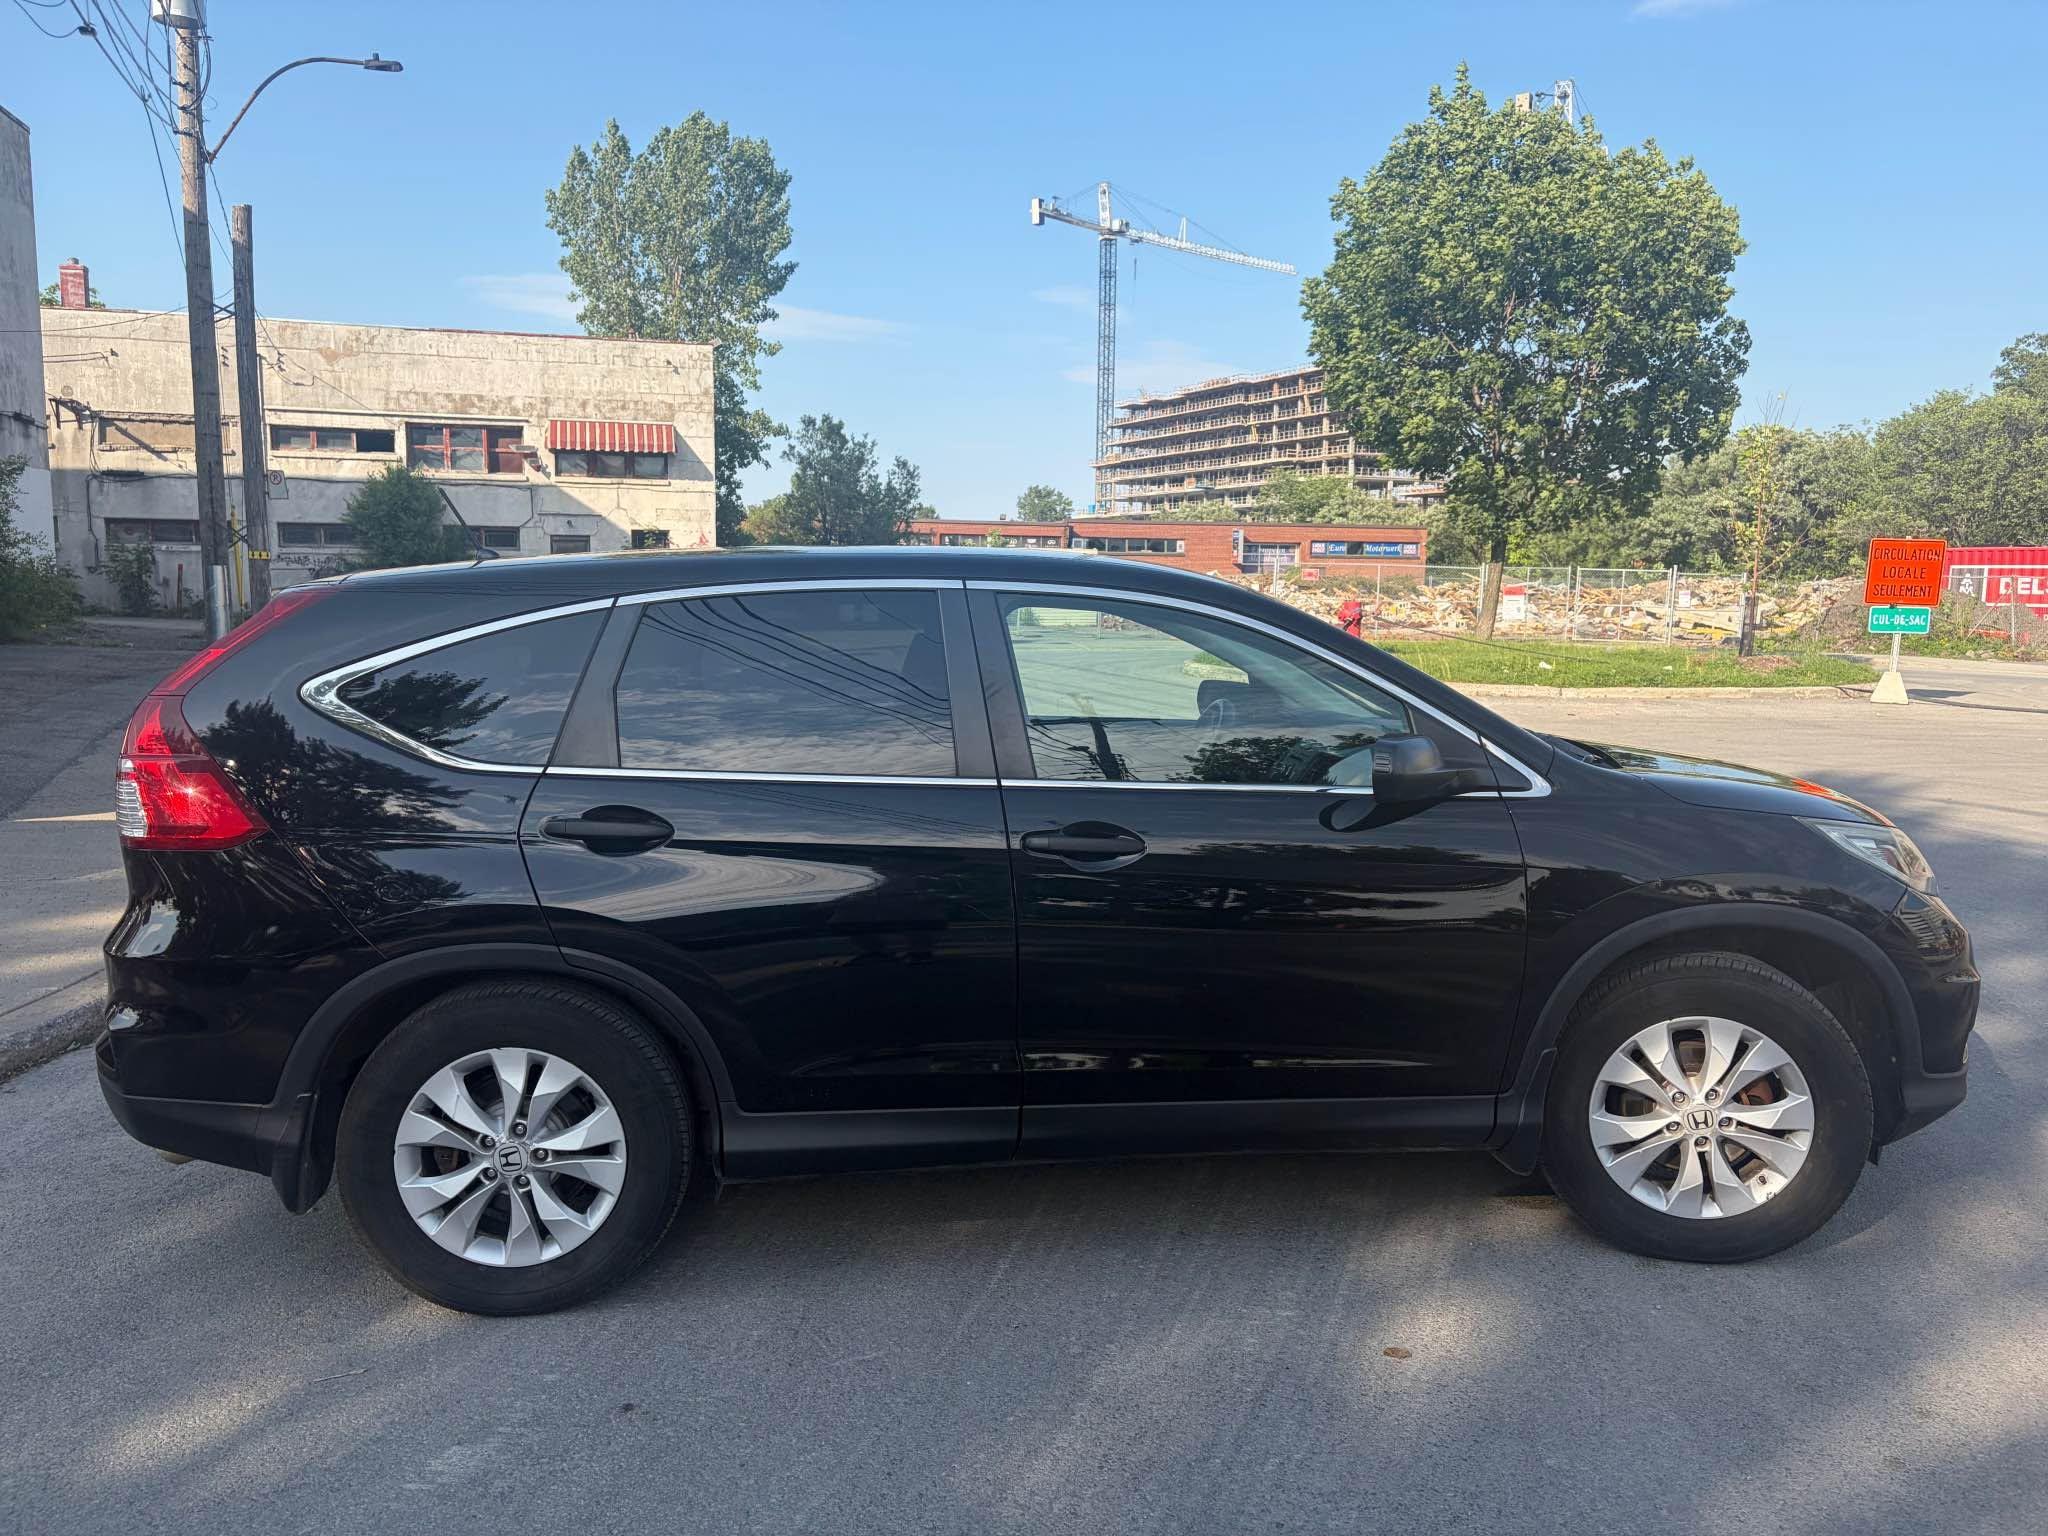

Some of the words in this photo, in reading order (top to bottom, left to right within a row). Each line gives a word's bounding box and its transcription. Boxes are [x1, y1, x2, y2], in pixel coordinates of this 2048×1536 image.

[1873, 547, 1941, 561] CIRCULATION
[1882, 566, 1927, 579] LOCALE
[1872, 584, 1933, 598] SEULEMENT
[1999, 577, 2048, 595] DEL
[1872, 614, 1927, 626] CUL-DE-SAC
